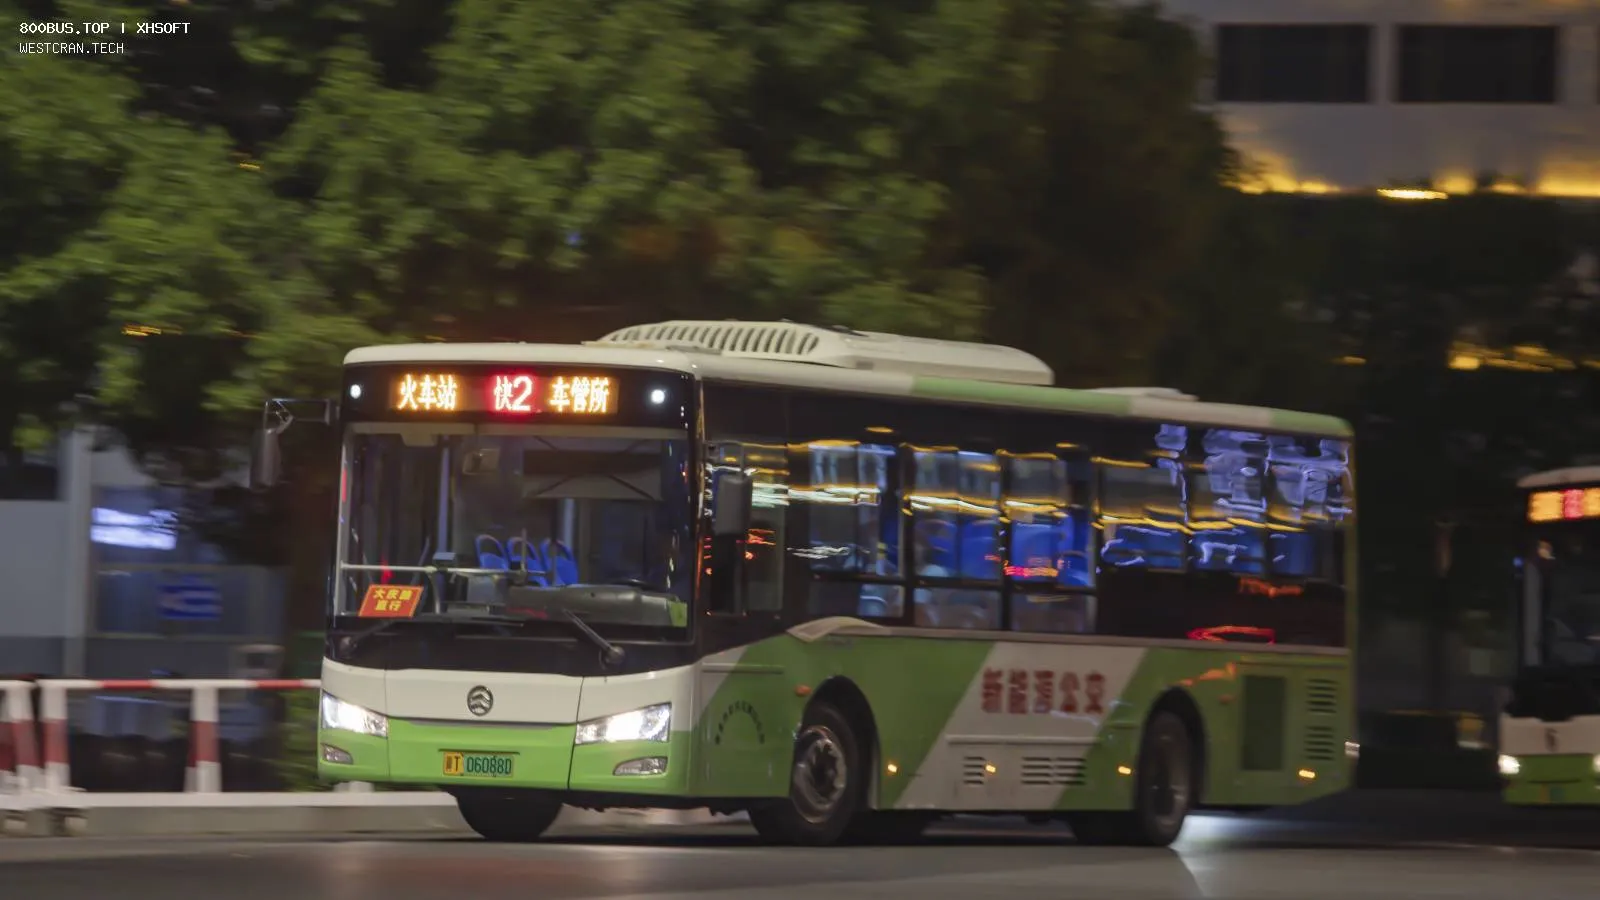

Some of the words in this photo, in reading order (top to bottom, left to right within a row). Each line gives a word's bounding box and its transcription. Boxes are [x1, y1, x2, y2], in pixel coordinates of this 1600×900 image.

[398, 374, 457, 411] 火车站
[549, 375, 610, 413] 车管所
[981, 667, 1106, 715] 新能源公交
